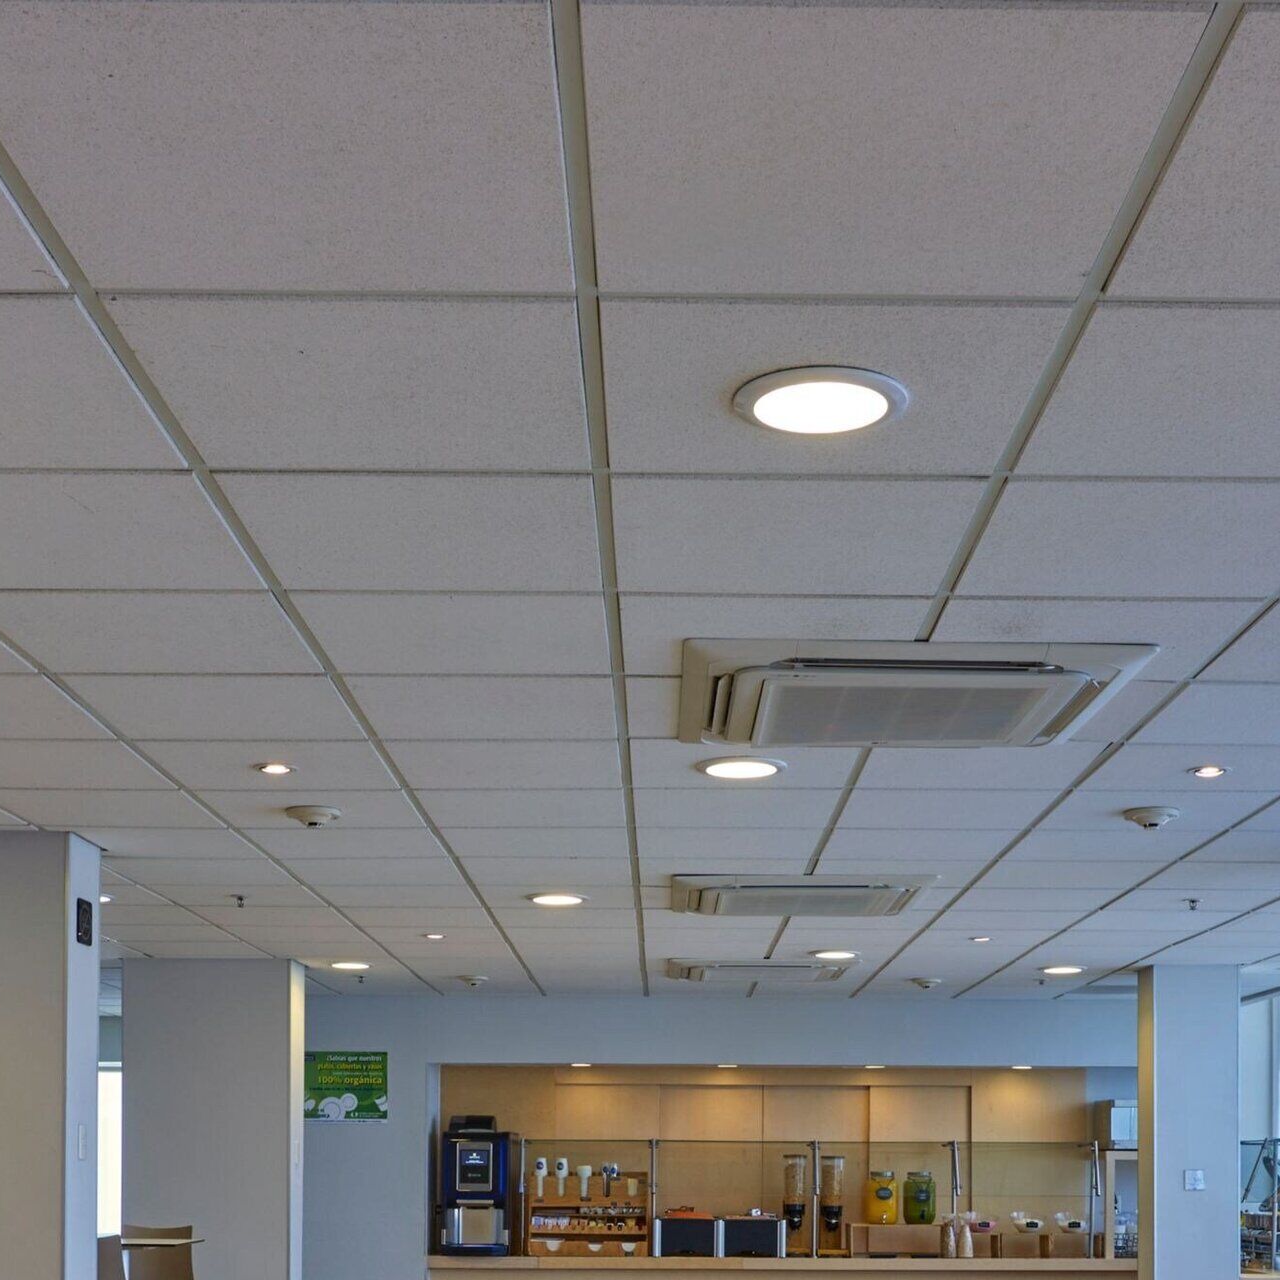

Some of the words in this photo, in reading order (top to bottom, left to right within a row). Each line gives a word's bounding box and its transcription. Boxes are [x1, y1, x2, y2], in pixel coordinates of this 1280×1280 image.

[347, 1055, 358, 1063] que
[318, 1075, 342, 1084] 100%
[343, 1074, 383, 1086] orgánica
